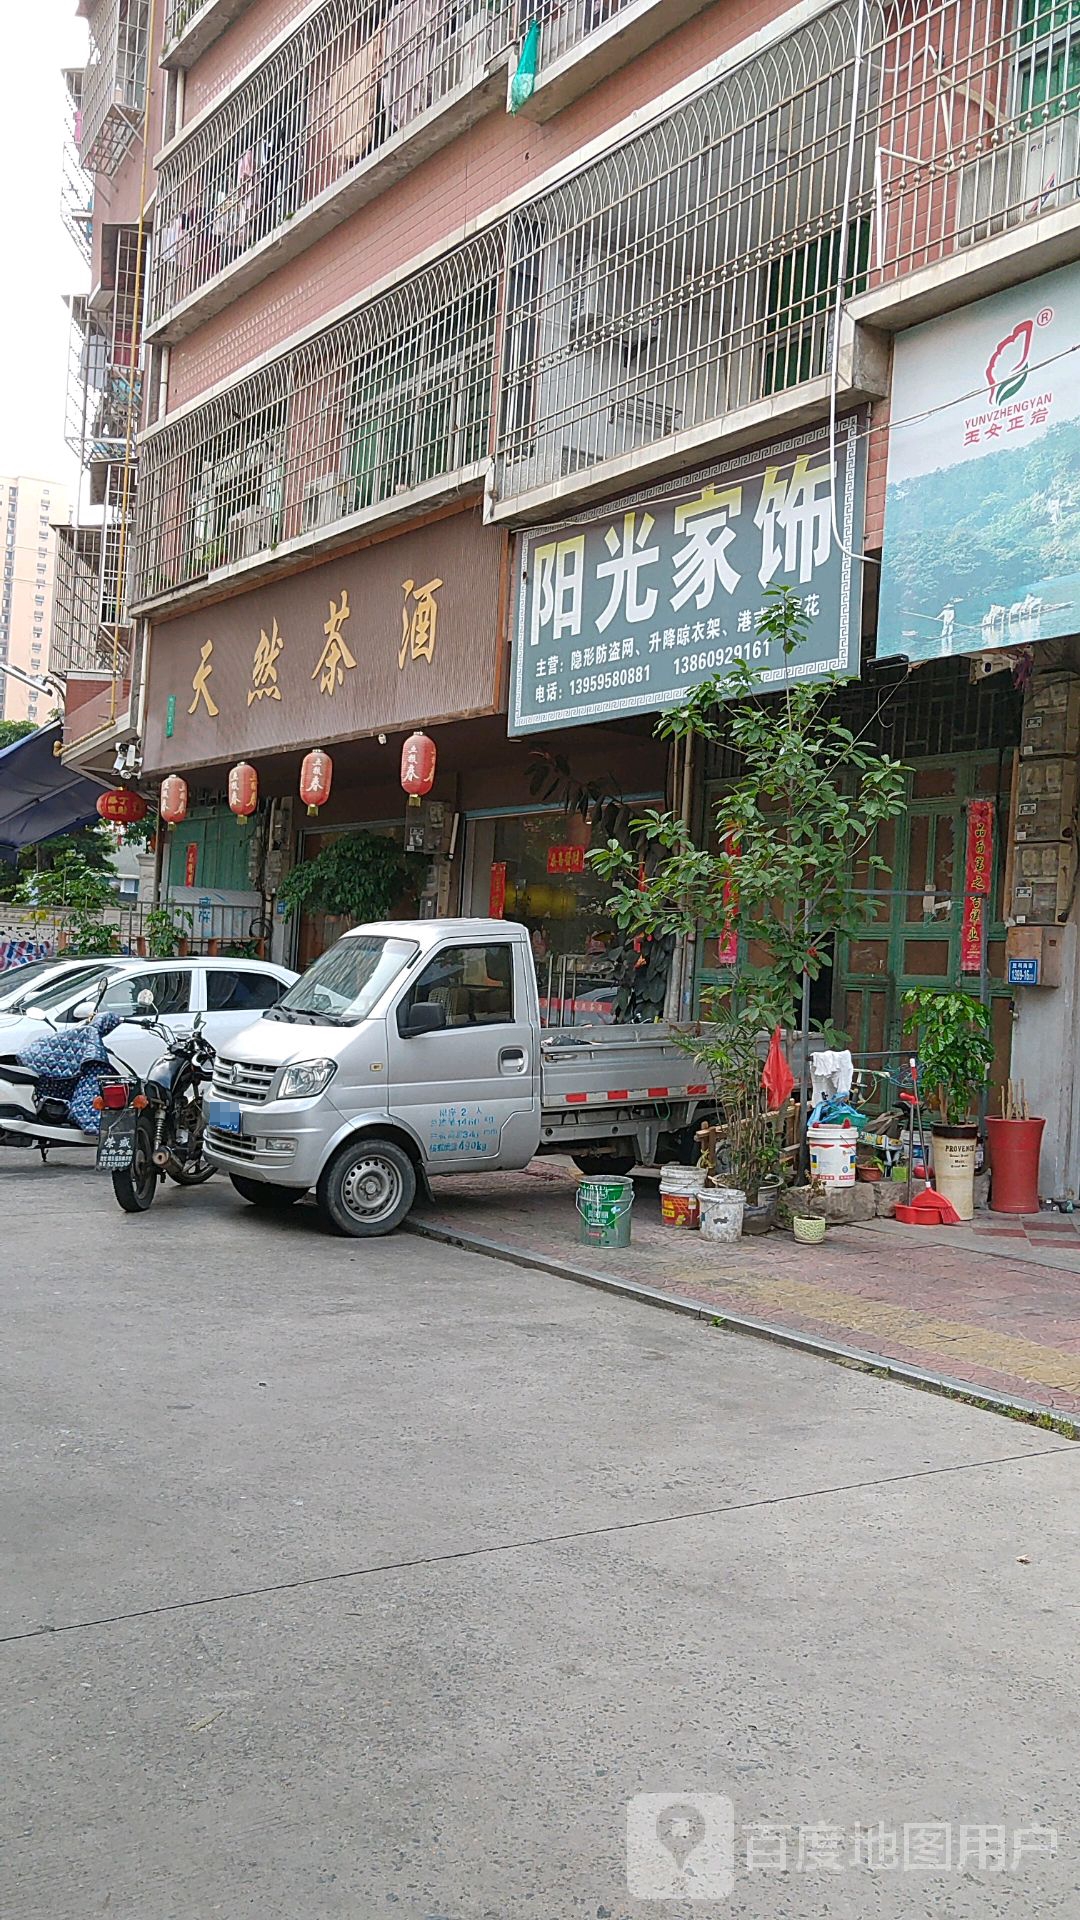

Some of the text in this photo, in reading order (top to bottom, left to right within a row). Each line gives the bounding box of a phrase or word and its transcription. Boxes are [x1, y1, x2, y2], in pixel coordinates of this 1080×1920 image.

[963, 407, 1049, 447] 玉女正岩
[964, 392, 1053, 430] YUNVZHENGYAN
[530, 454, 838, 647] 阳光家饰
[187, 577, 444, 717] 天然茶酒
[673, 638, 771, 676] 13860929161
